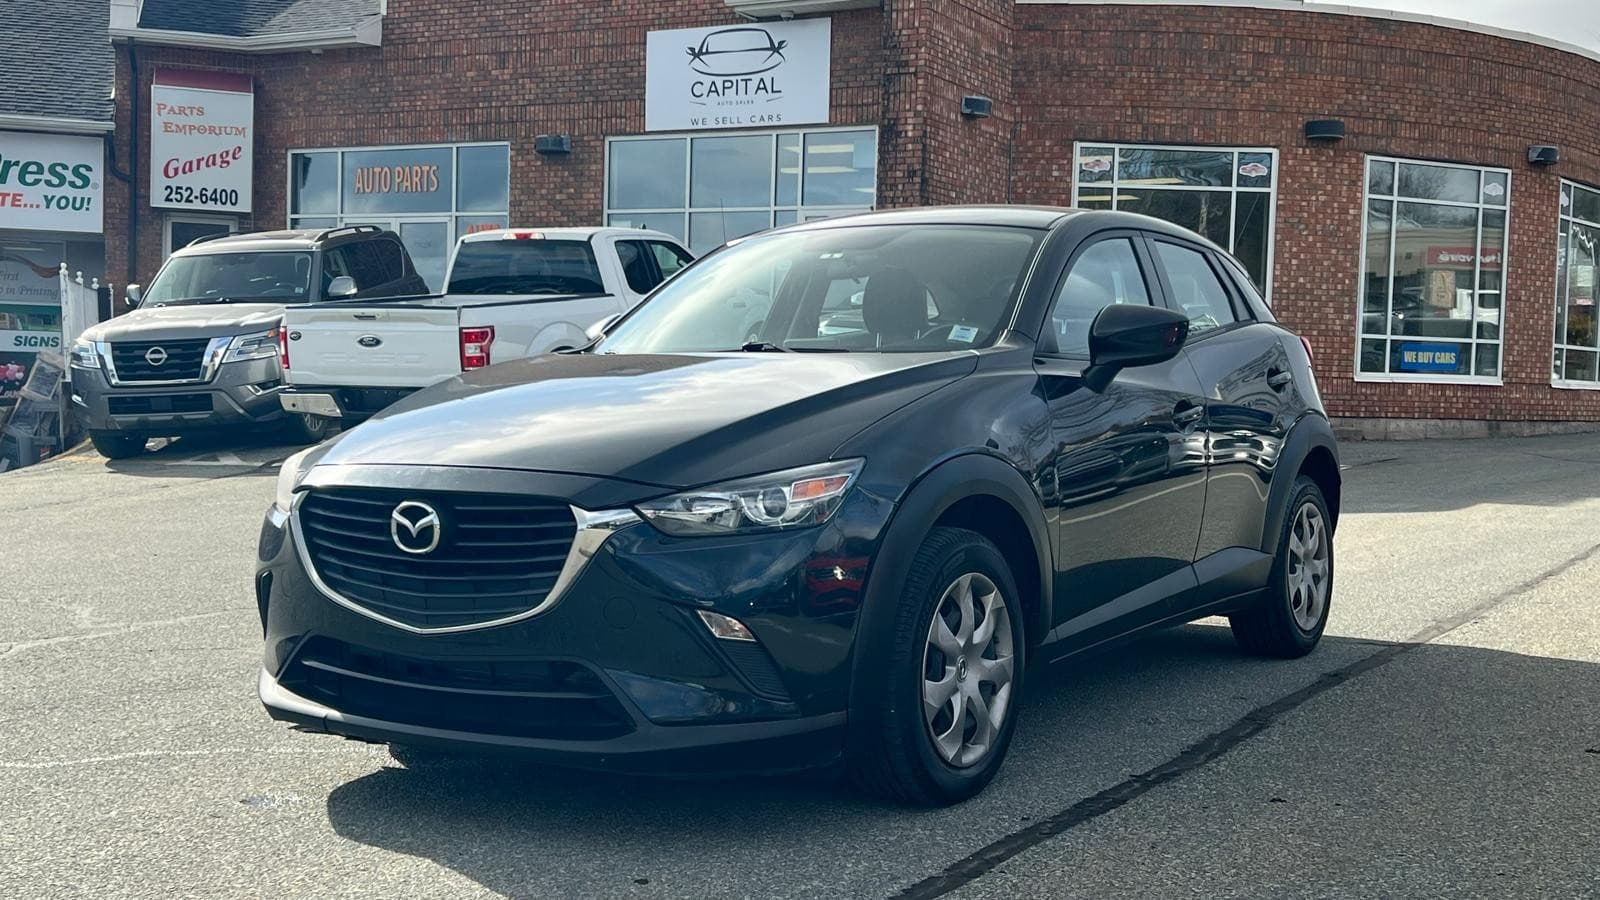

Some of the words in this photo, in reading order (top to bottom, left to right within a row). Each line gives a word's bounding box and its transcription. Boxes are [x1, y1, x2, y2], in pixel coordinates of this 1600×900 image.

[690, 77, 782, 98] CAPITAL
[691, 117, 708, 126] WE
[714, 116, 742, 124] SELL
[749, 114, 782, 123] CARS
[0, 153, 94, 190] ress
[163, 145, 242, 179] Garage
[354, 166, 392, 194] AUTO
[394, 165, 439, 193] PARTS
[164, 185, 238, 206] 252-6400
[14, 335, 60, 348] SIGNS
[1404, 351, 1417, 363] WE
[1417, 351, 1435, 364] BUY
[1434, 351, 1457, 364] CARS
